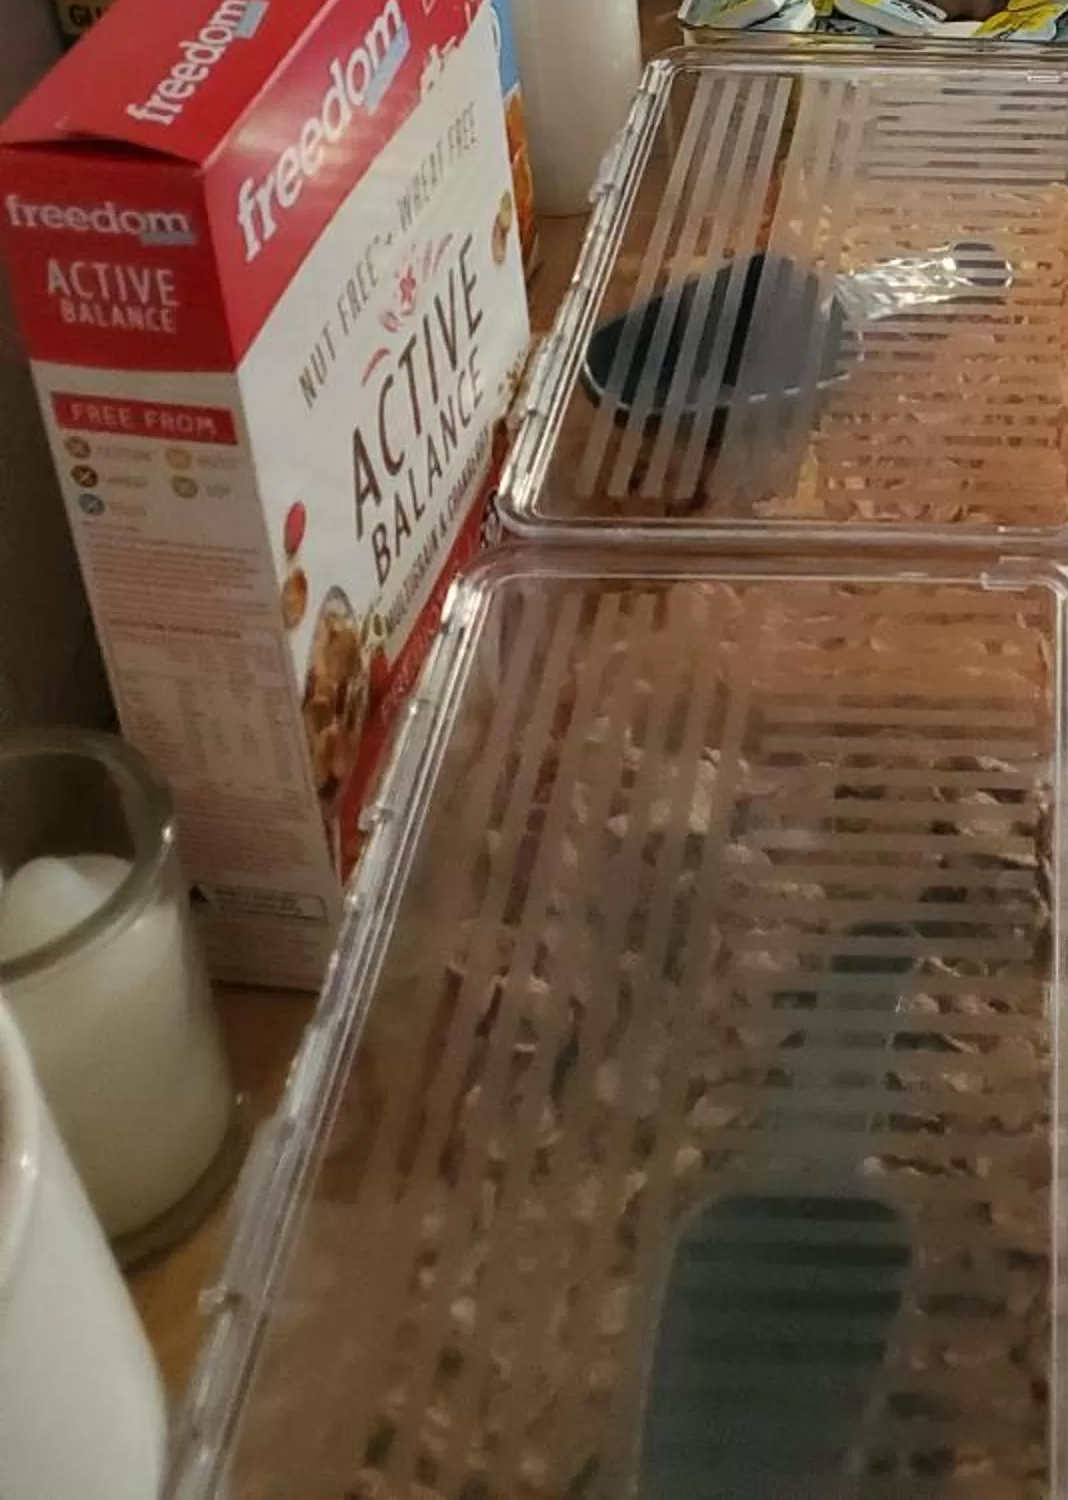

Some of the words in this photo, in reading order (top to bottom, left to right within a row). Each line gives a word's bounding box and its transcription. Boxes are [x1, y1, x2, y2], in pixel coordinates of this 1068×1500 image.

[6, 193, 191, 236] freedom
[47, 257, 180, 308] ACTIVE
[60, 303, 178, 334] BALANCE
[298, 318, 337, 410] NUT
[350, 233, 483, 539] ACTIVE
[70, 402, 133, 429] FREE
[144, 405, 218, 437] FROM
[371, 344, 484, 588] BALANCE
